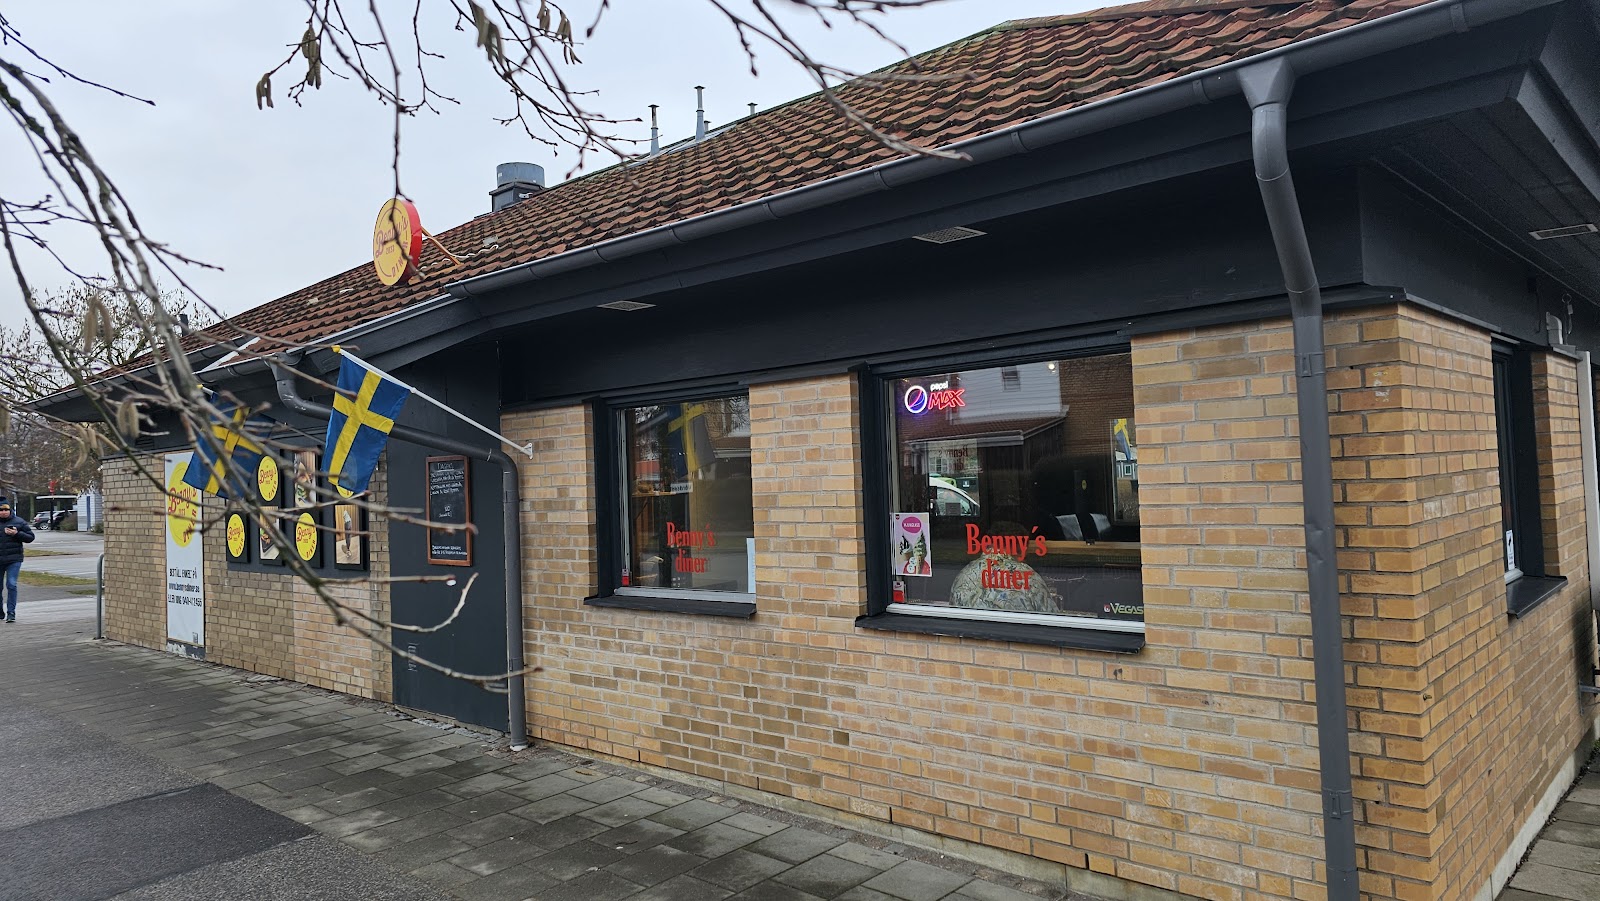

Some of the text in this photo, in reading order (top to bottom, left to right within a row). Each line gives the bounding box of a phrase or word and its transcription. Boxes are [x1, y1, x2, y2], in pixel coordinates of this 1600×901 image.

[930, 380, 949, 392] pepsi
[927, 388, 966, 410] MAX
[666, 521, 716, 552] Benny's
[965, 523, 1048, 562] Benny's
[675, 548, 707, 573] diner
[981, 558, 1034, 590] diner
[1110, 602, 1144, 615] VEGAS
